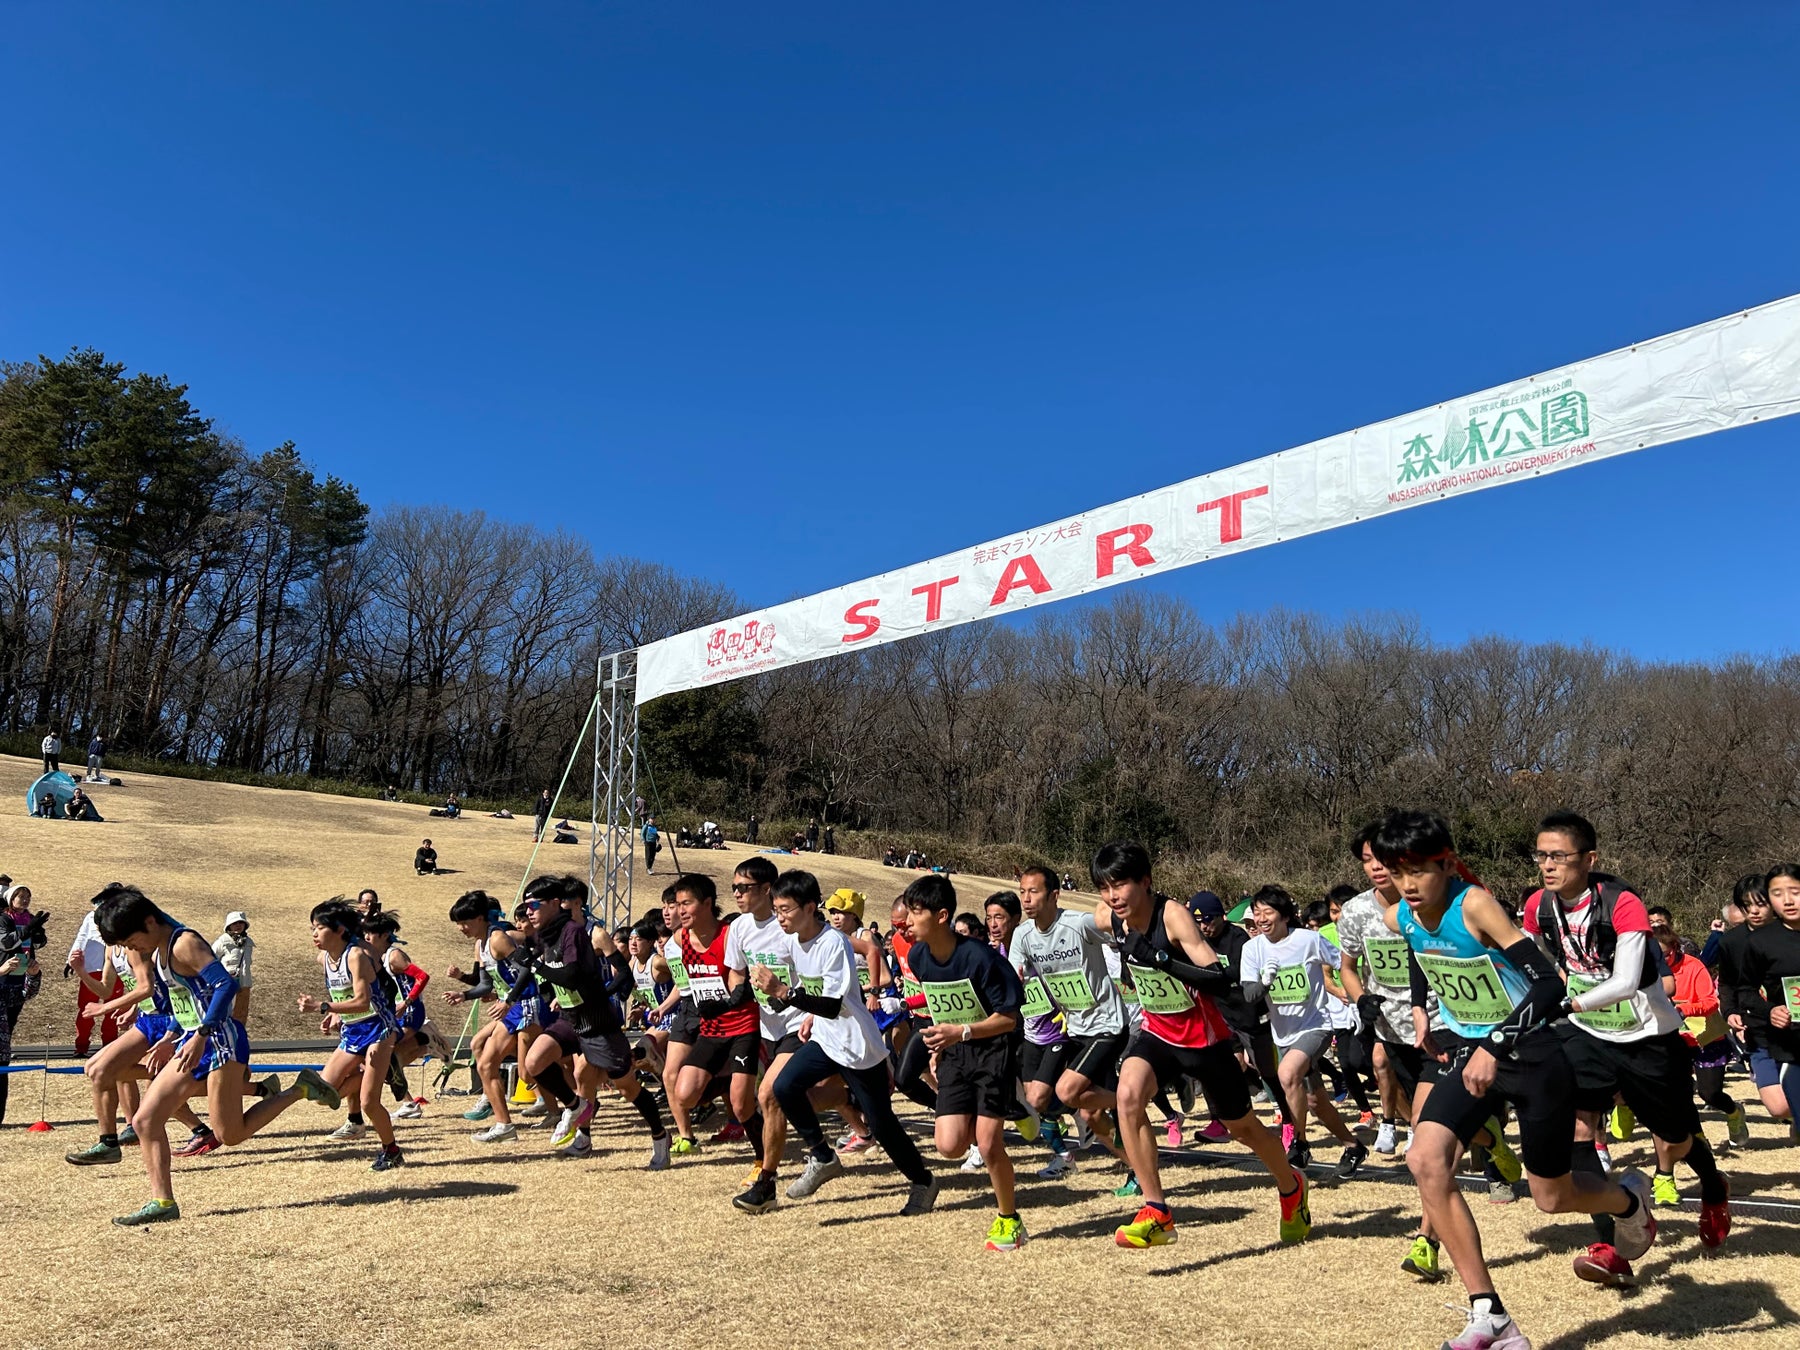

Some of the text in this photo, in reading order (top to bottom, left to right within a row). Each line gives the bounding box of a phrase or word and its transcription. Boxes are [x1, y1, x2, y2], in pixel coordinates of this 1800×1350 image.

[1396, 390, 1590, 485] 森林公園
[1388, 441, 1597, 504] MUSASHI-KYURYO NATIONAL GOVERNMENT PARK
[972, 520, 1083, 567] 完走マラソン大会
[842, 485, 1269, 642] START
[1029, 946, 1082, 964] MoveSport
[688, 963, 719, 975] M高史
[1049, 979, 1087, 998] 3111
[1135, 975, 1179, 998] 3531
[1427, 970, 1497, 1002] 3501
[929, 991, 976, 1014] 3505
